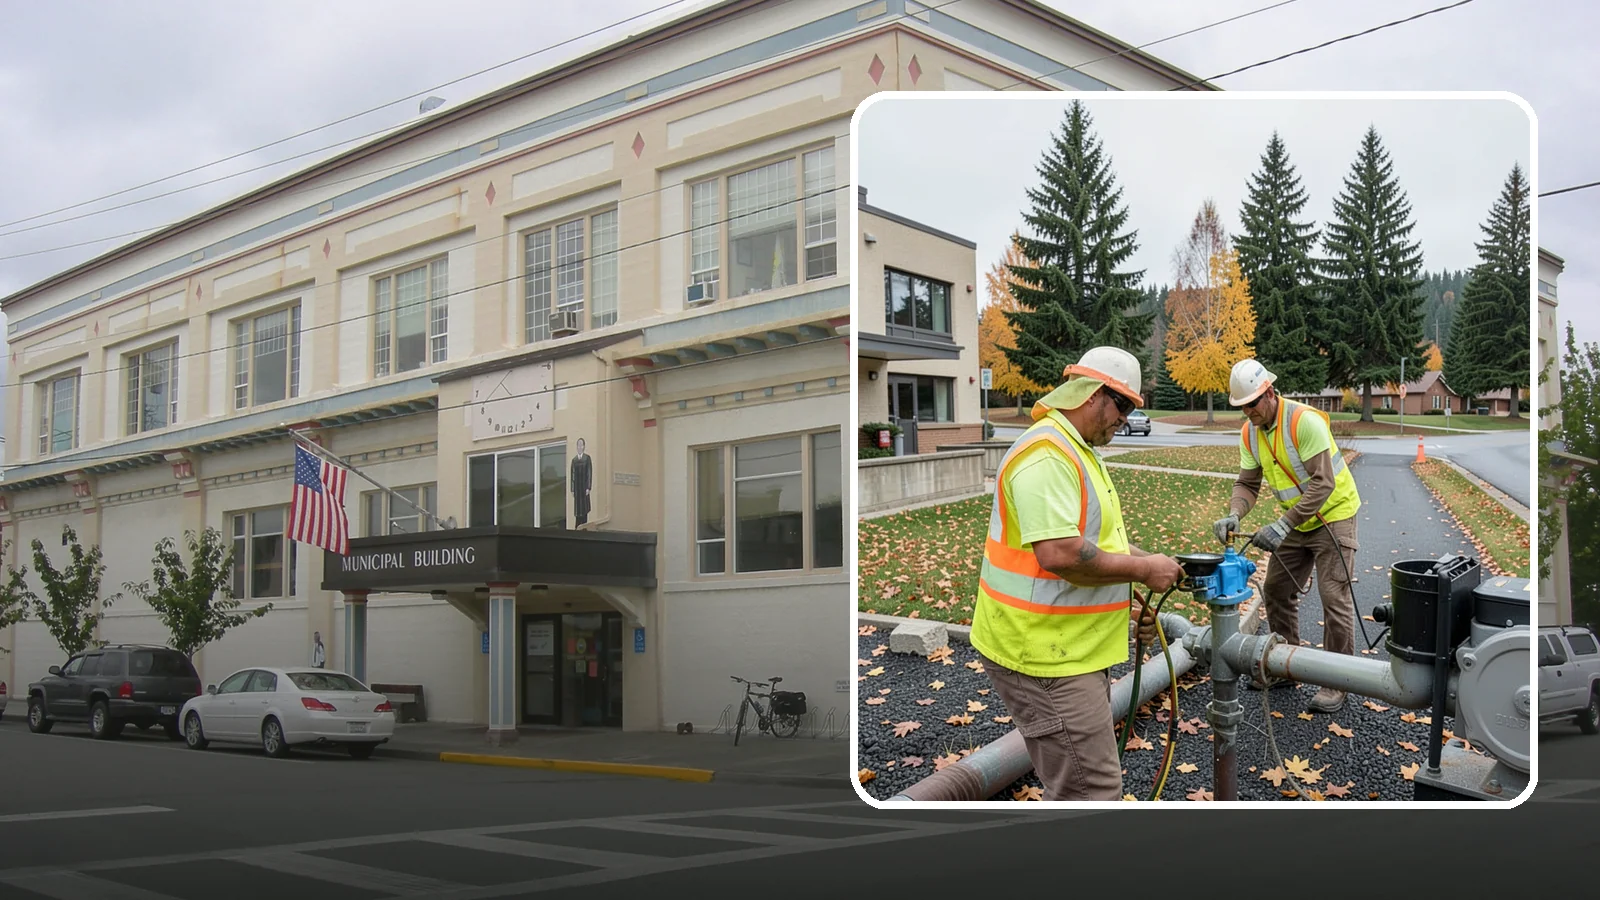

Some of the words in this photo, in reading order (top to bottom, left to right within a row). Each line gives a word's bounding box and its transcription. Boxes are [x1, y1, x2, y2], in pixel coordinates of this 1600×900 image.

[475, 390, 479, 398] 7
[480, 406, 484, 415] 8
[488, 417, 492, 426] 9
[494, 424, 500, 432] 10
[521, 420, 525, 428] 2
[529, 414, 533, 422] 3
[342, 552, 405, 572] MUNICIPAL
[414, 546, 475, 567] BUILDING
